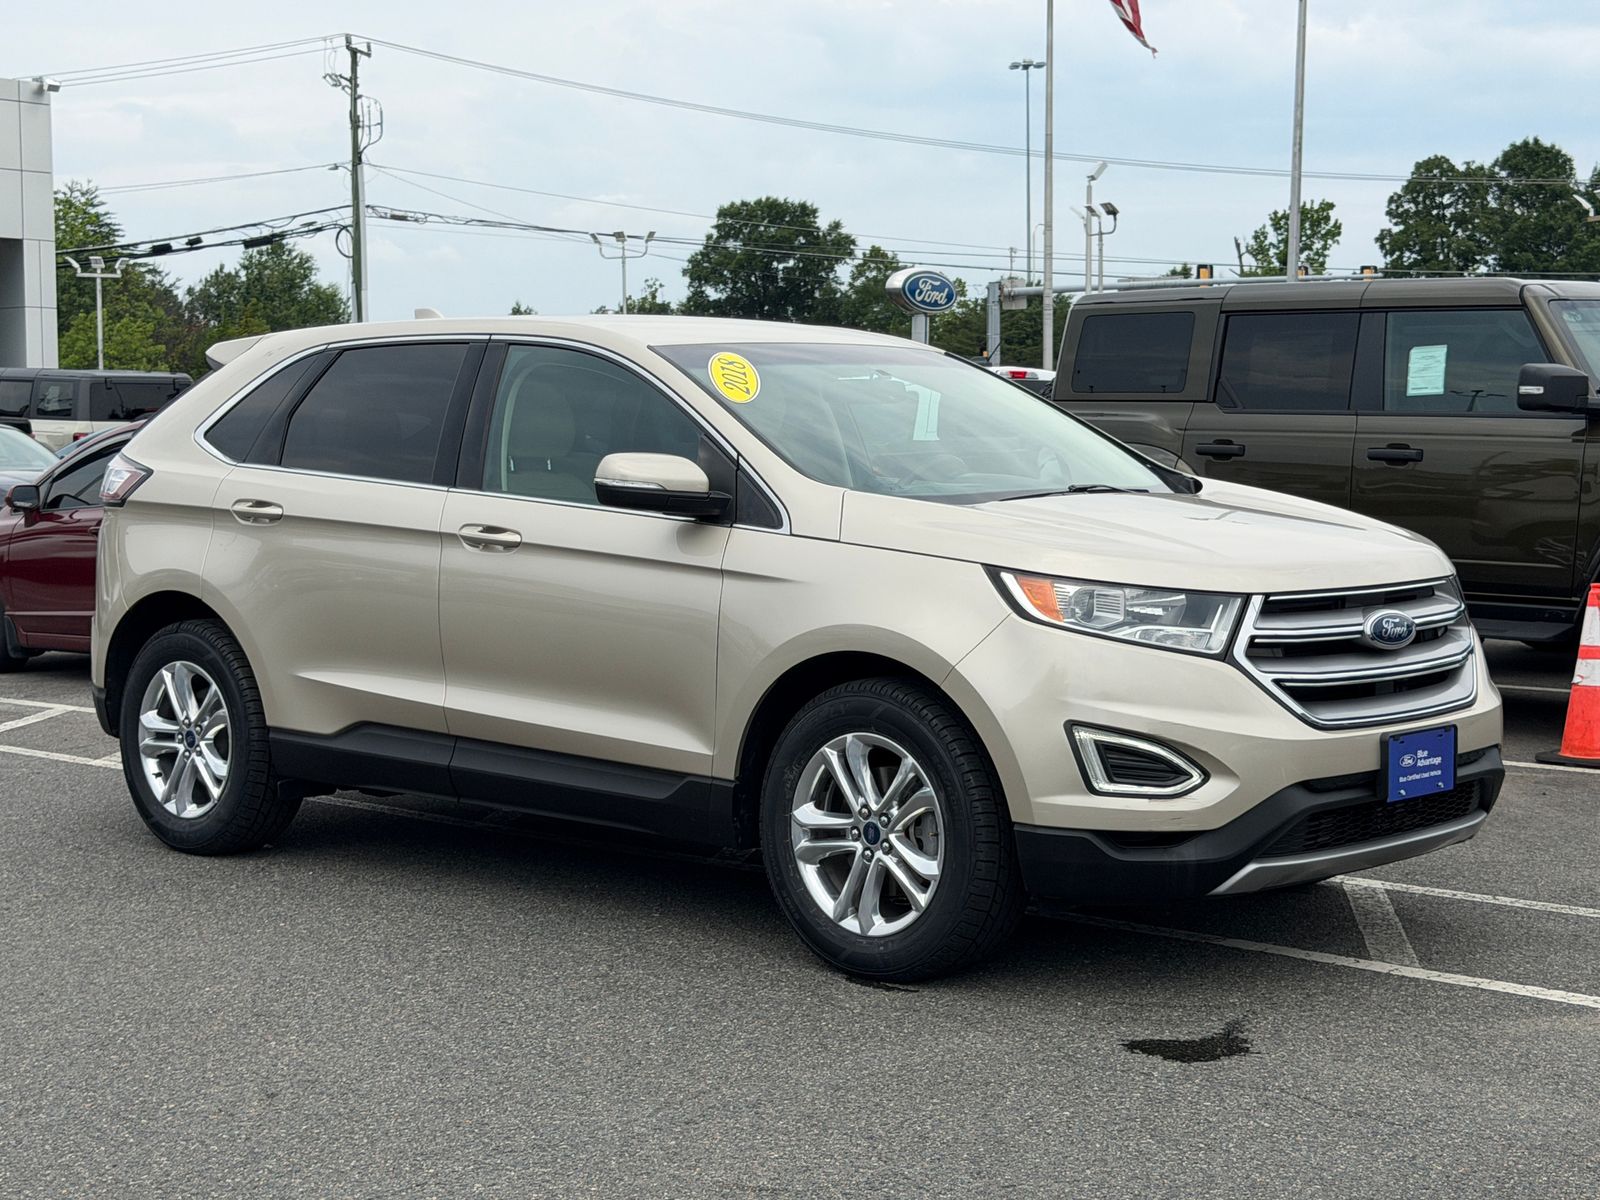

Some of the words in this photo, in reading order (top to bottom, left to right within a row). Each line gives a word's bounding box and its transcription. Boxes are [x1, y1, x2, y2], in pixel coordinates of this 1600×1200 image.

[915, 278, 949, 305] Ford
[718, 357, 750, 395] 2018
[1382, 618, 1408, 640] Ford
[1416, 756, 1442, 767] Advantage
[1417, 749, 1428, 758] Blue
